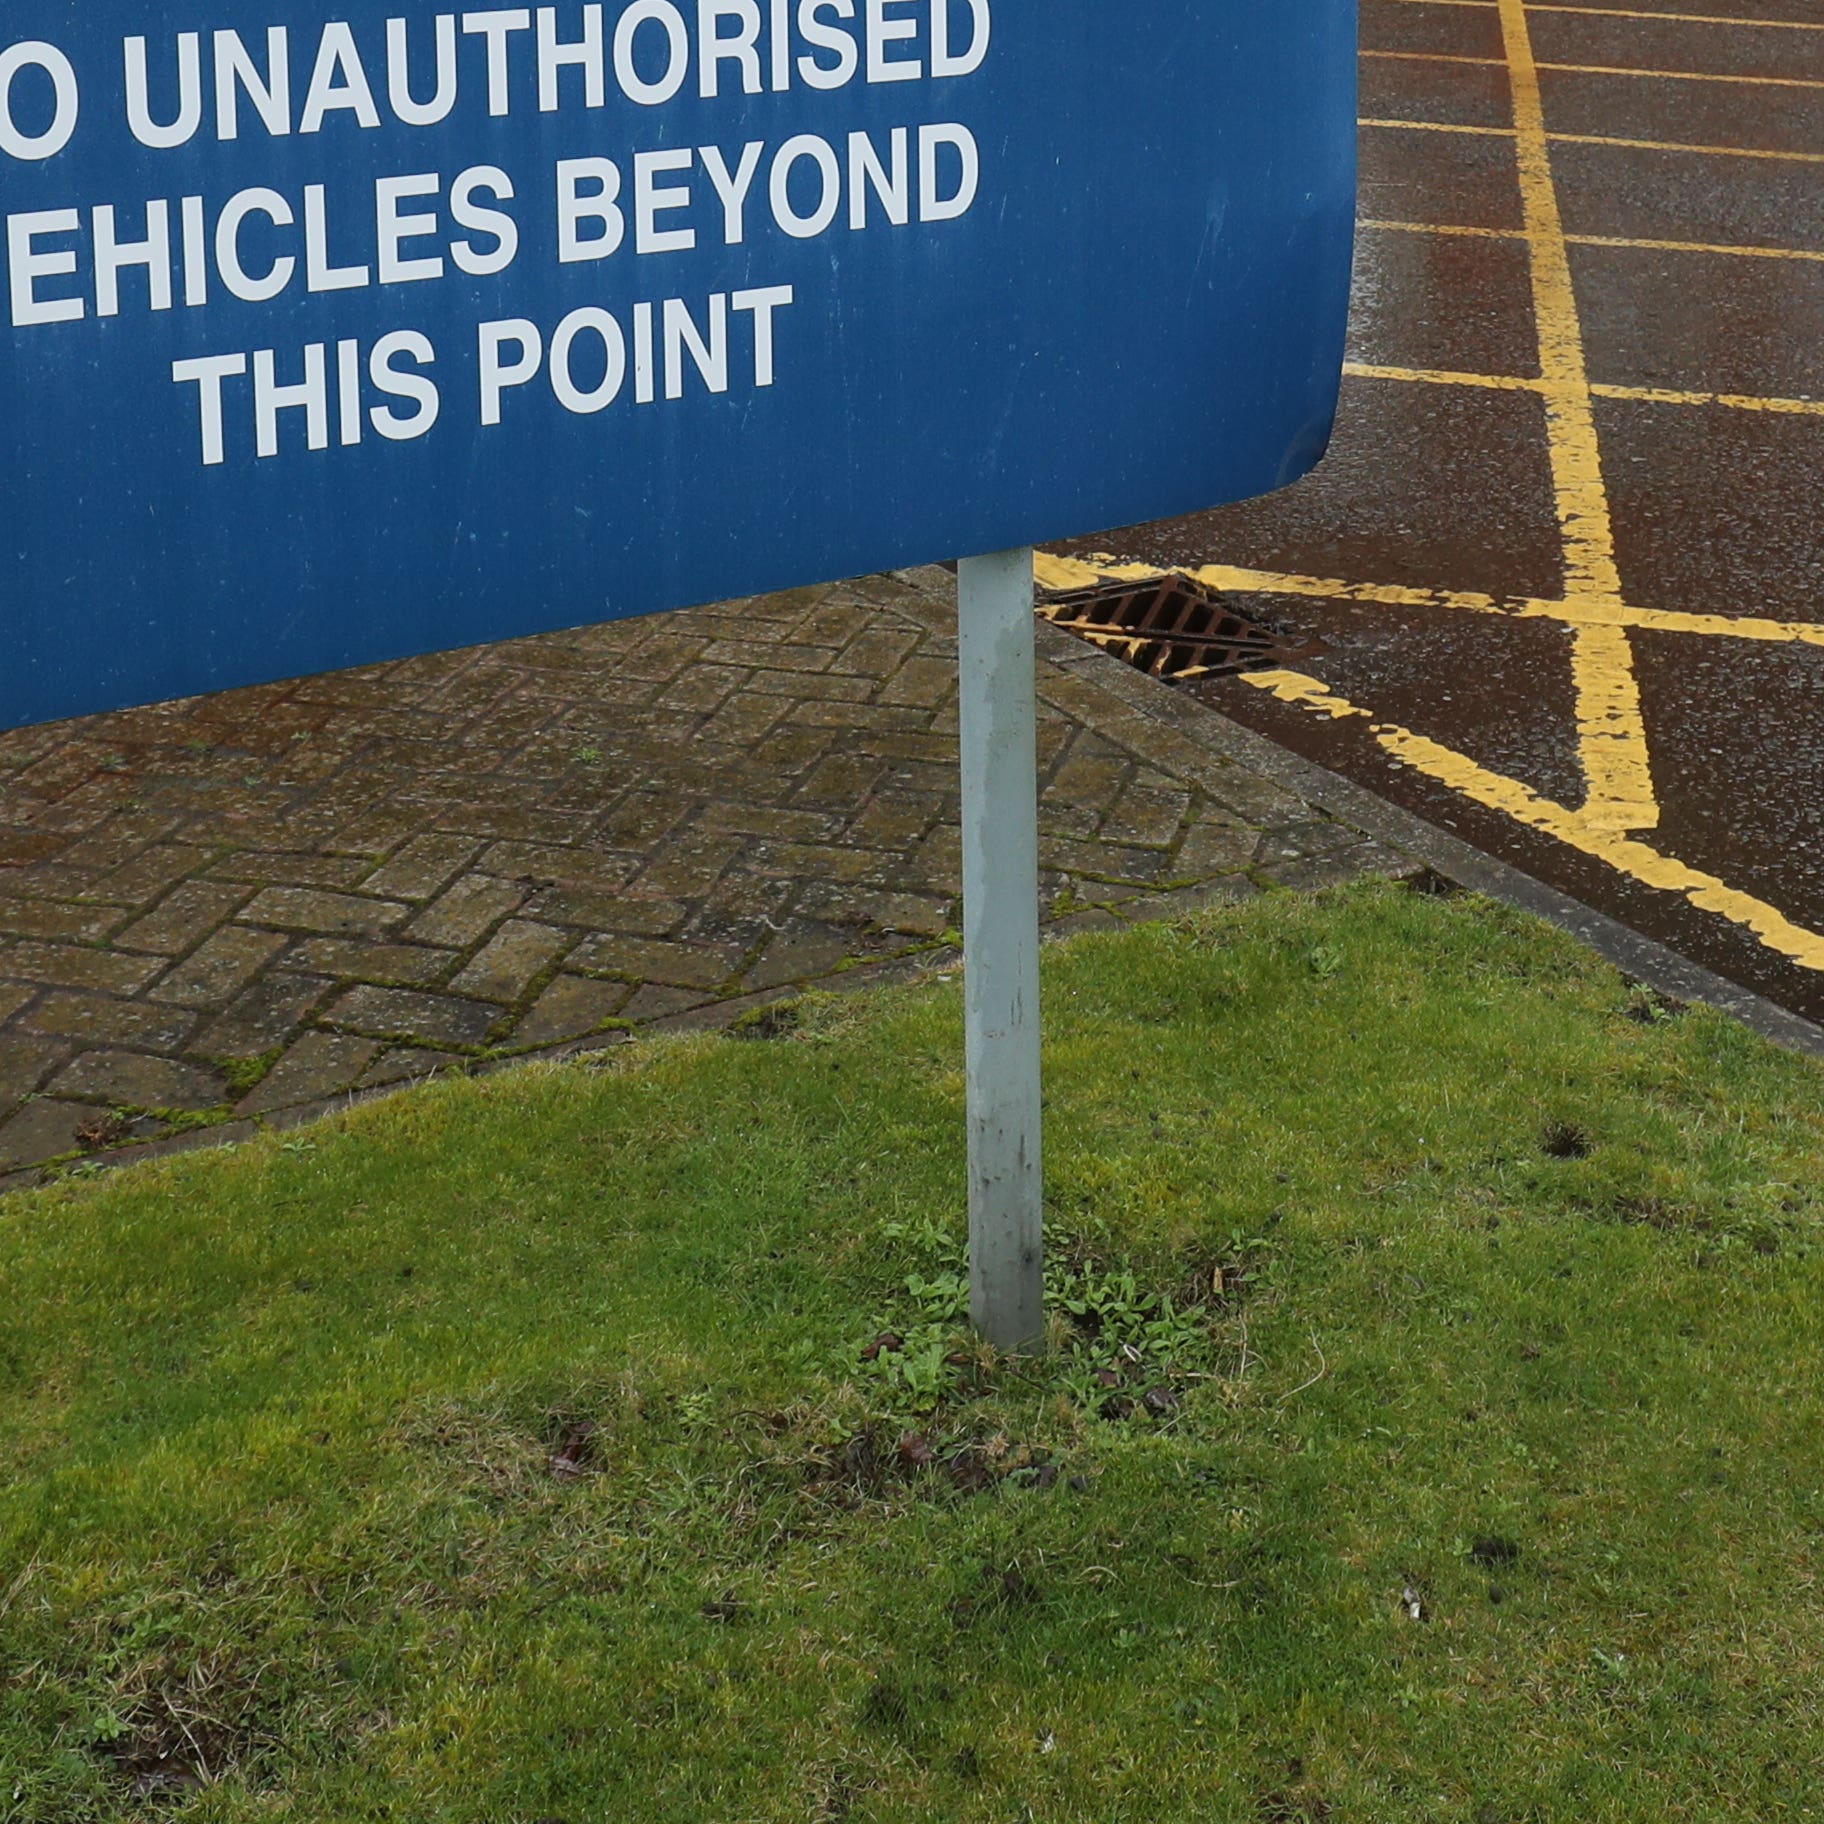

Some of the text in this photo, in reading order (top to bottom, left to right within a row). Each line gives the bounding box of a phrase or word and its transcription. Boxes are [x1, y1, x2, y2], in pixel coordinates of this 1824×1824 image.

[555, 121, 980, 264] BEYOND
[171, 283, 794, 466] THIS POINT
